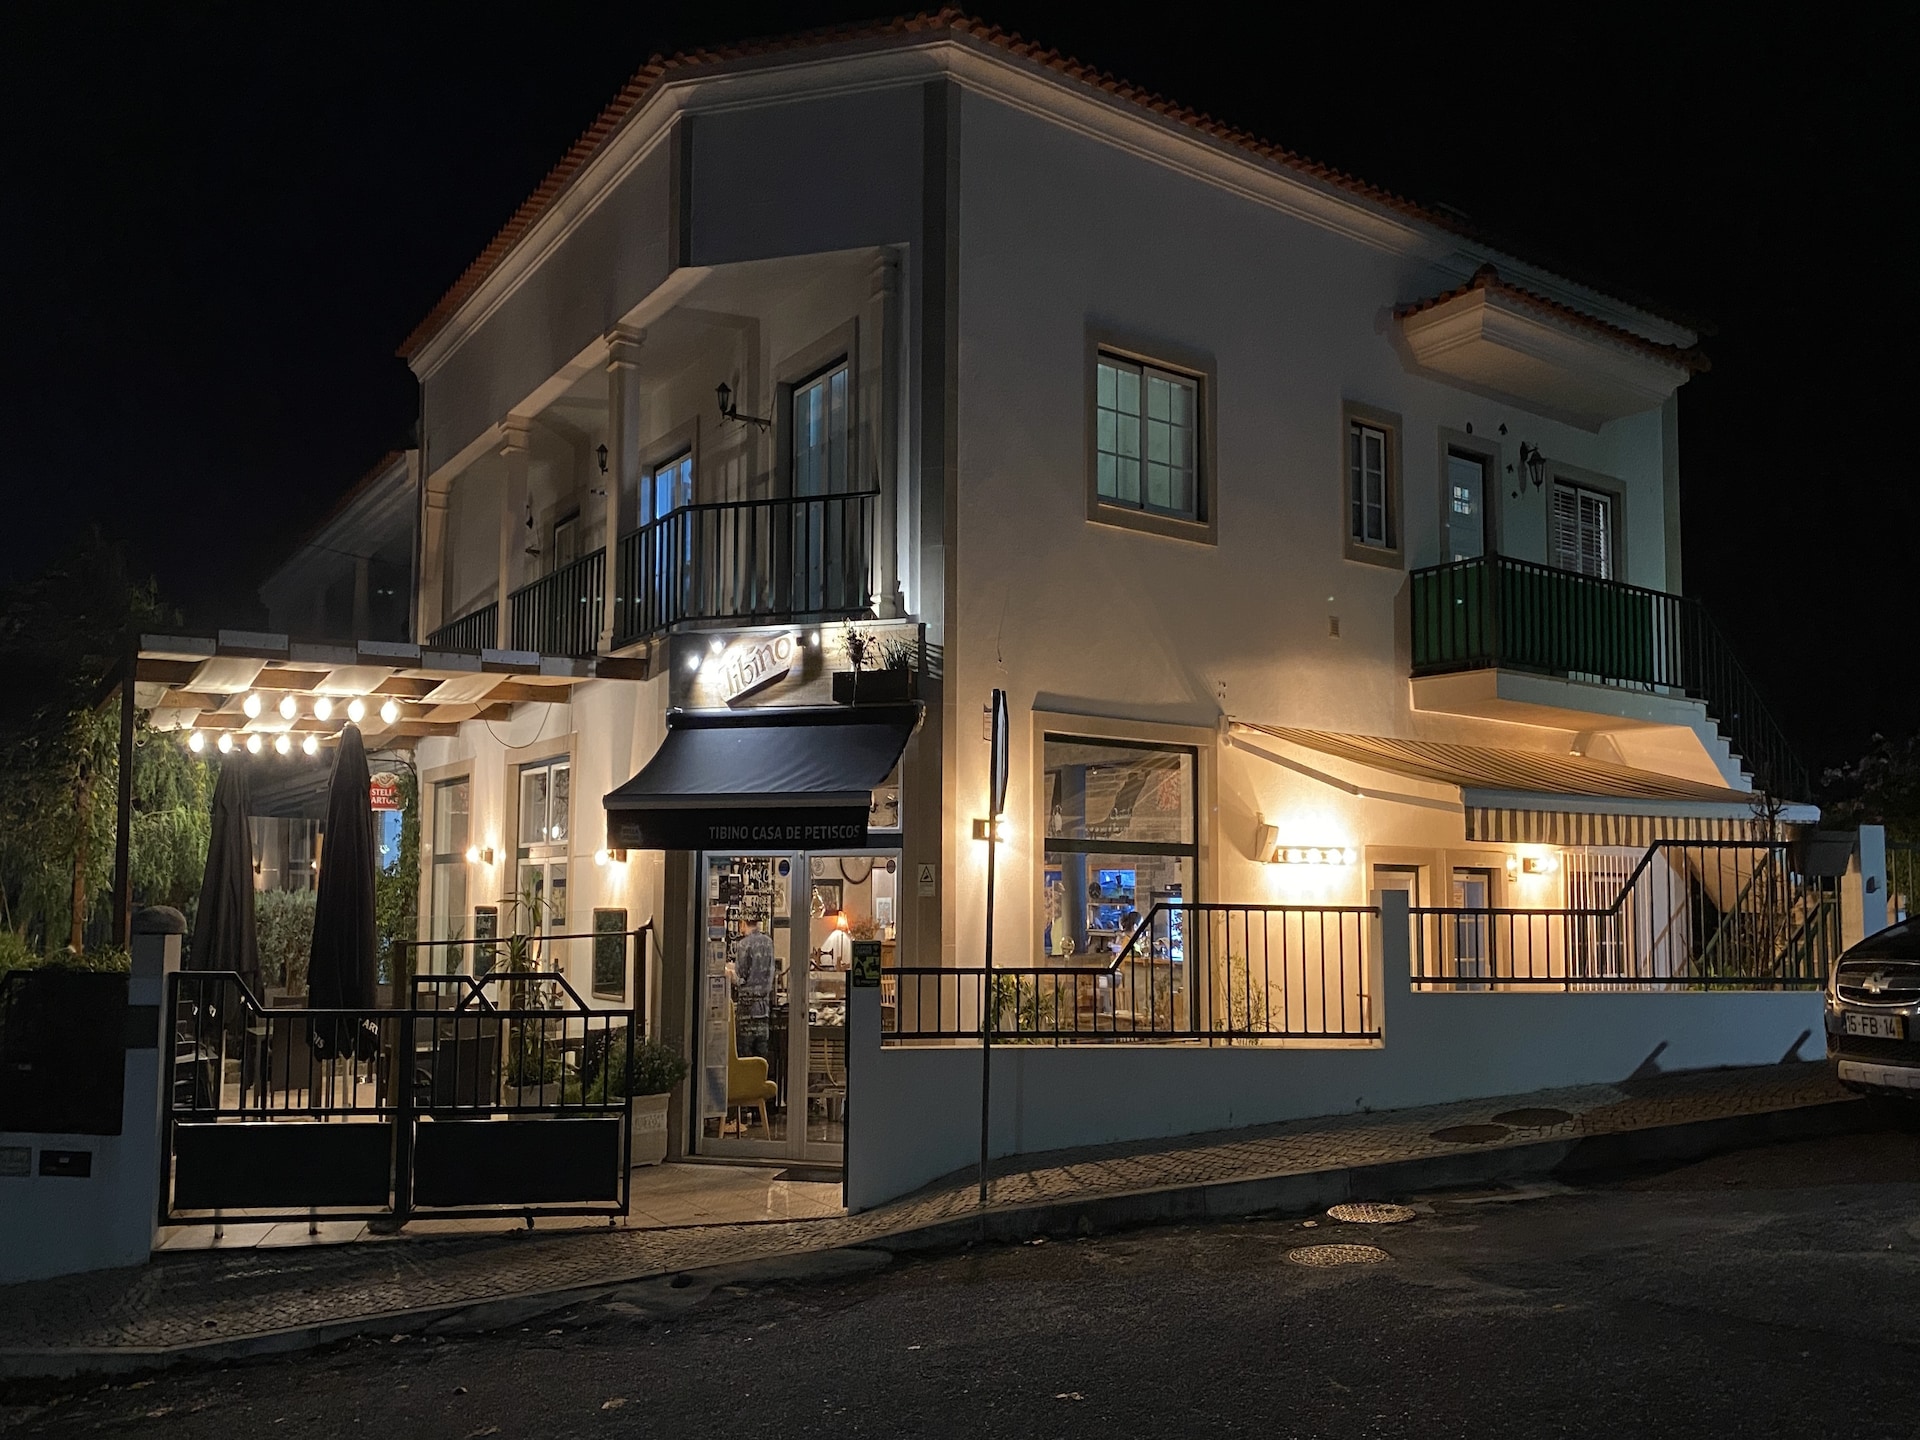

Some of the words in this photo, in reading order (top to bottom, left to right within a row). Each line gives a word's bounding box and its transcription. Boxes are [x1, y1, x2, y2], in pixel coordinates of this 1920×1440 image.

[709, 826, 748, 840] TIBINO
[752, 826, 782, 840] CASA
[786, 826, 800, 839] DE
[804, 825, 860, 840] PETISCOS
